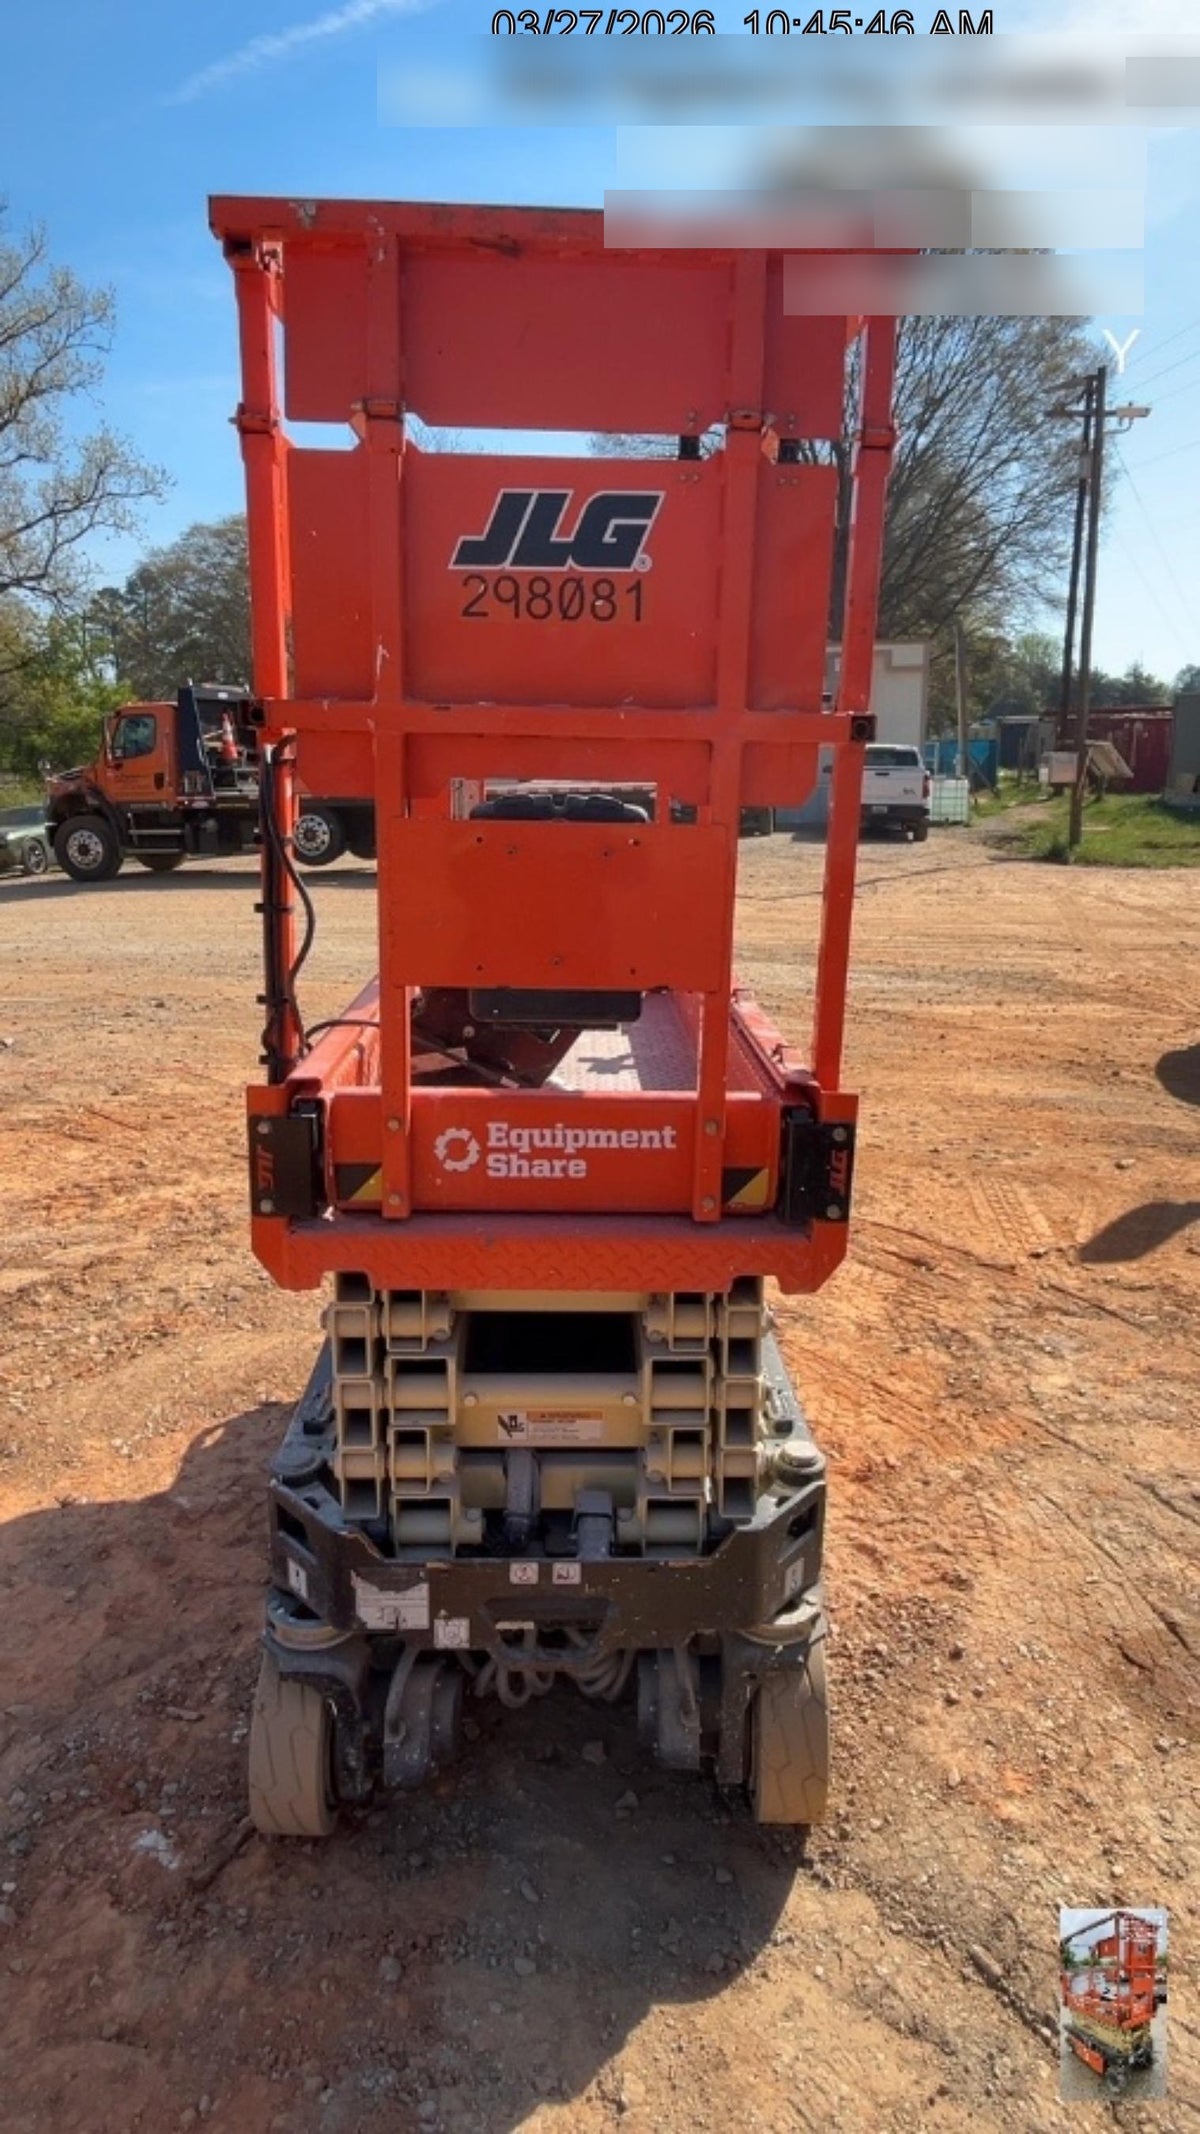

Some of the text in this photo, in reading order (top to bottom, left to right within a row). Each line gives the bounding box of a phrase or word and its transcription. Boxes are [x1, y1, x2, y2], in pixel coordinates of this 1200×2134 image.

[449, 488, 665, 572] JLG
[461, 574, 643, 622] 298081
[486, 1122, 676, 1153] Equipment
[486, 1154, 587, 1178] Share
